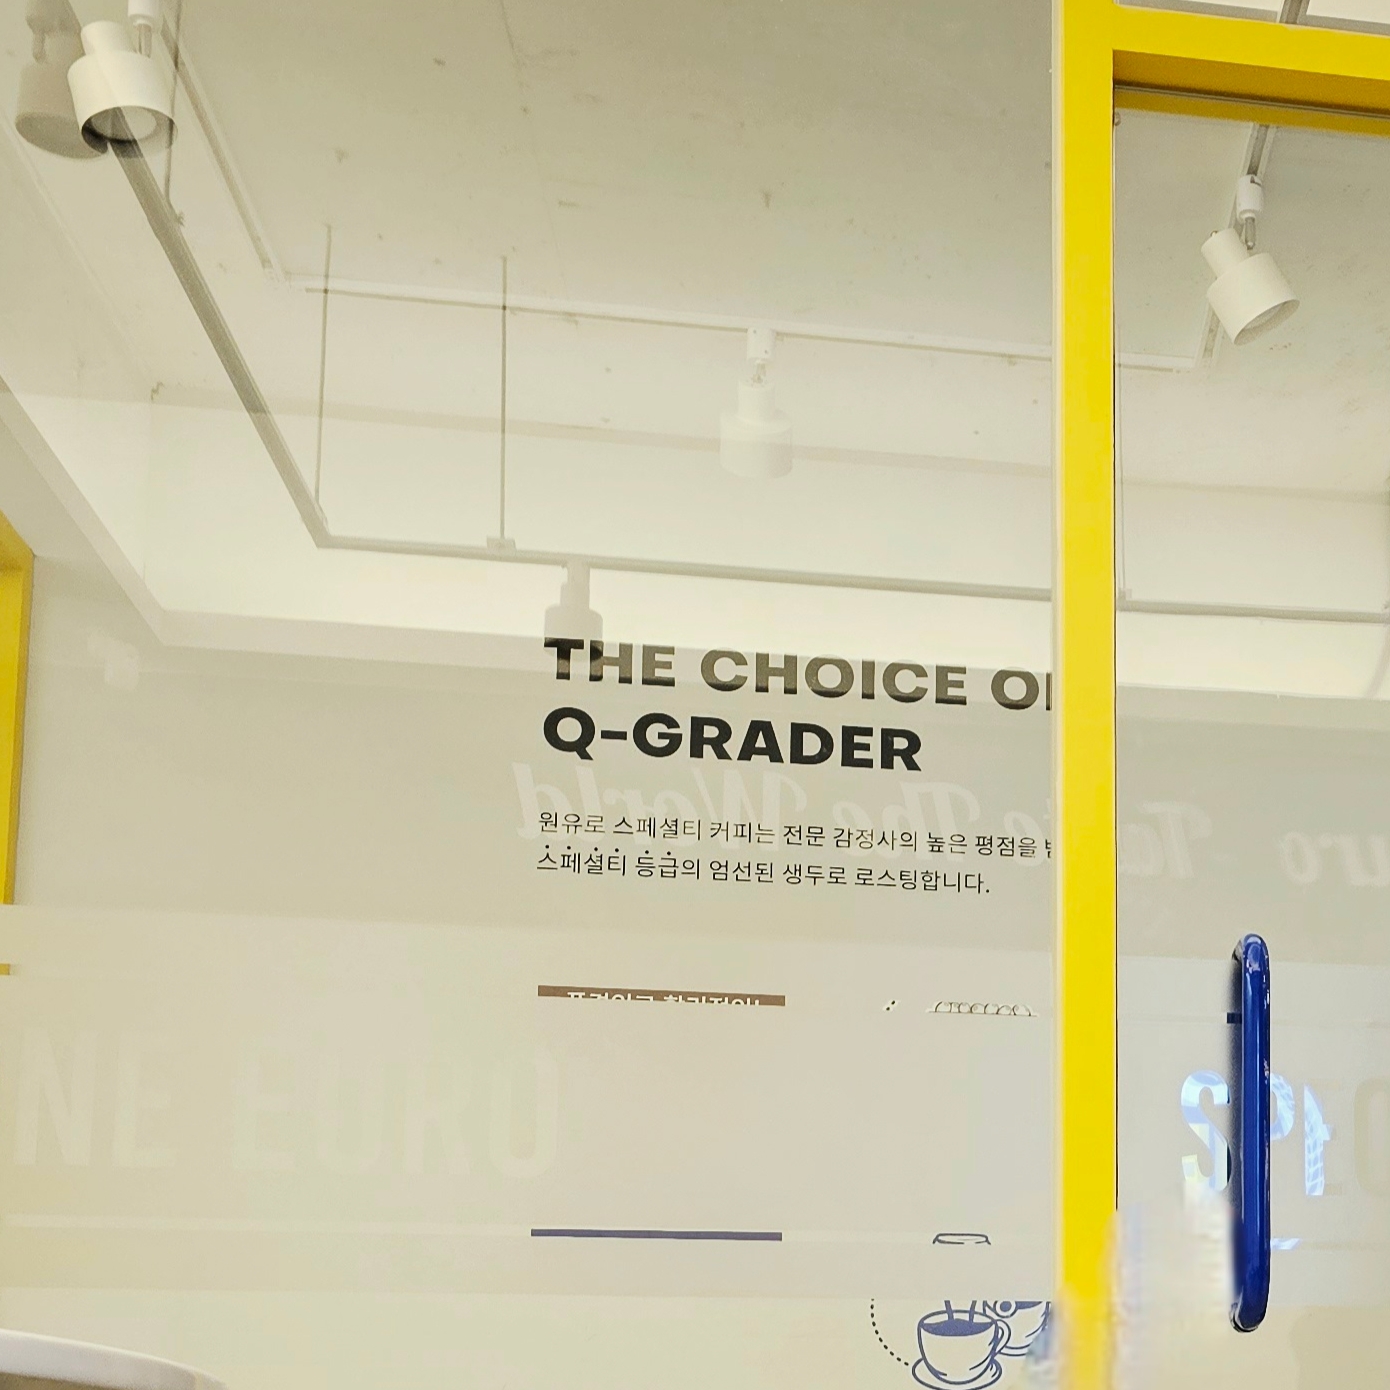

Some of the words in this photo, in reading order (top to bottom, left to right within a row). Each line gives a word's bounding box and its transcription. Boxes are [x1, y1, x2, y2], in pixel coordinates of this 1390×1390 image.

[543, 637, 676, 687] THE
[700, 647, 968, 705] CHOICE
[542, 706, 923, 771] Q-GRADER
[538, 811, 606, 835] 원유로
[612, 816, 702, 841] 스페셜티
[709, 820, 776, 845] 커피는
[782, 824, 826, 848] 전문
[832, 827, 918, 853] 감정사의
[926, 831, 969, 855] 높은
[974, 834, 1038, 859] 평점을
[536, 848, 627, 877] 스페셜티
[635, 851, 701, 880] 등급의
[709, 859, 775, 884] 엄선된
[782, 863, 848, 887] 생두로
[854, 866, 991, 895] 로스팅합니다.
